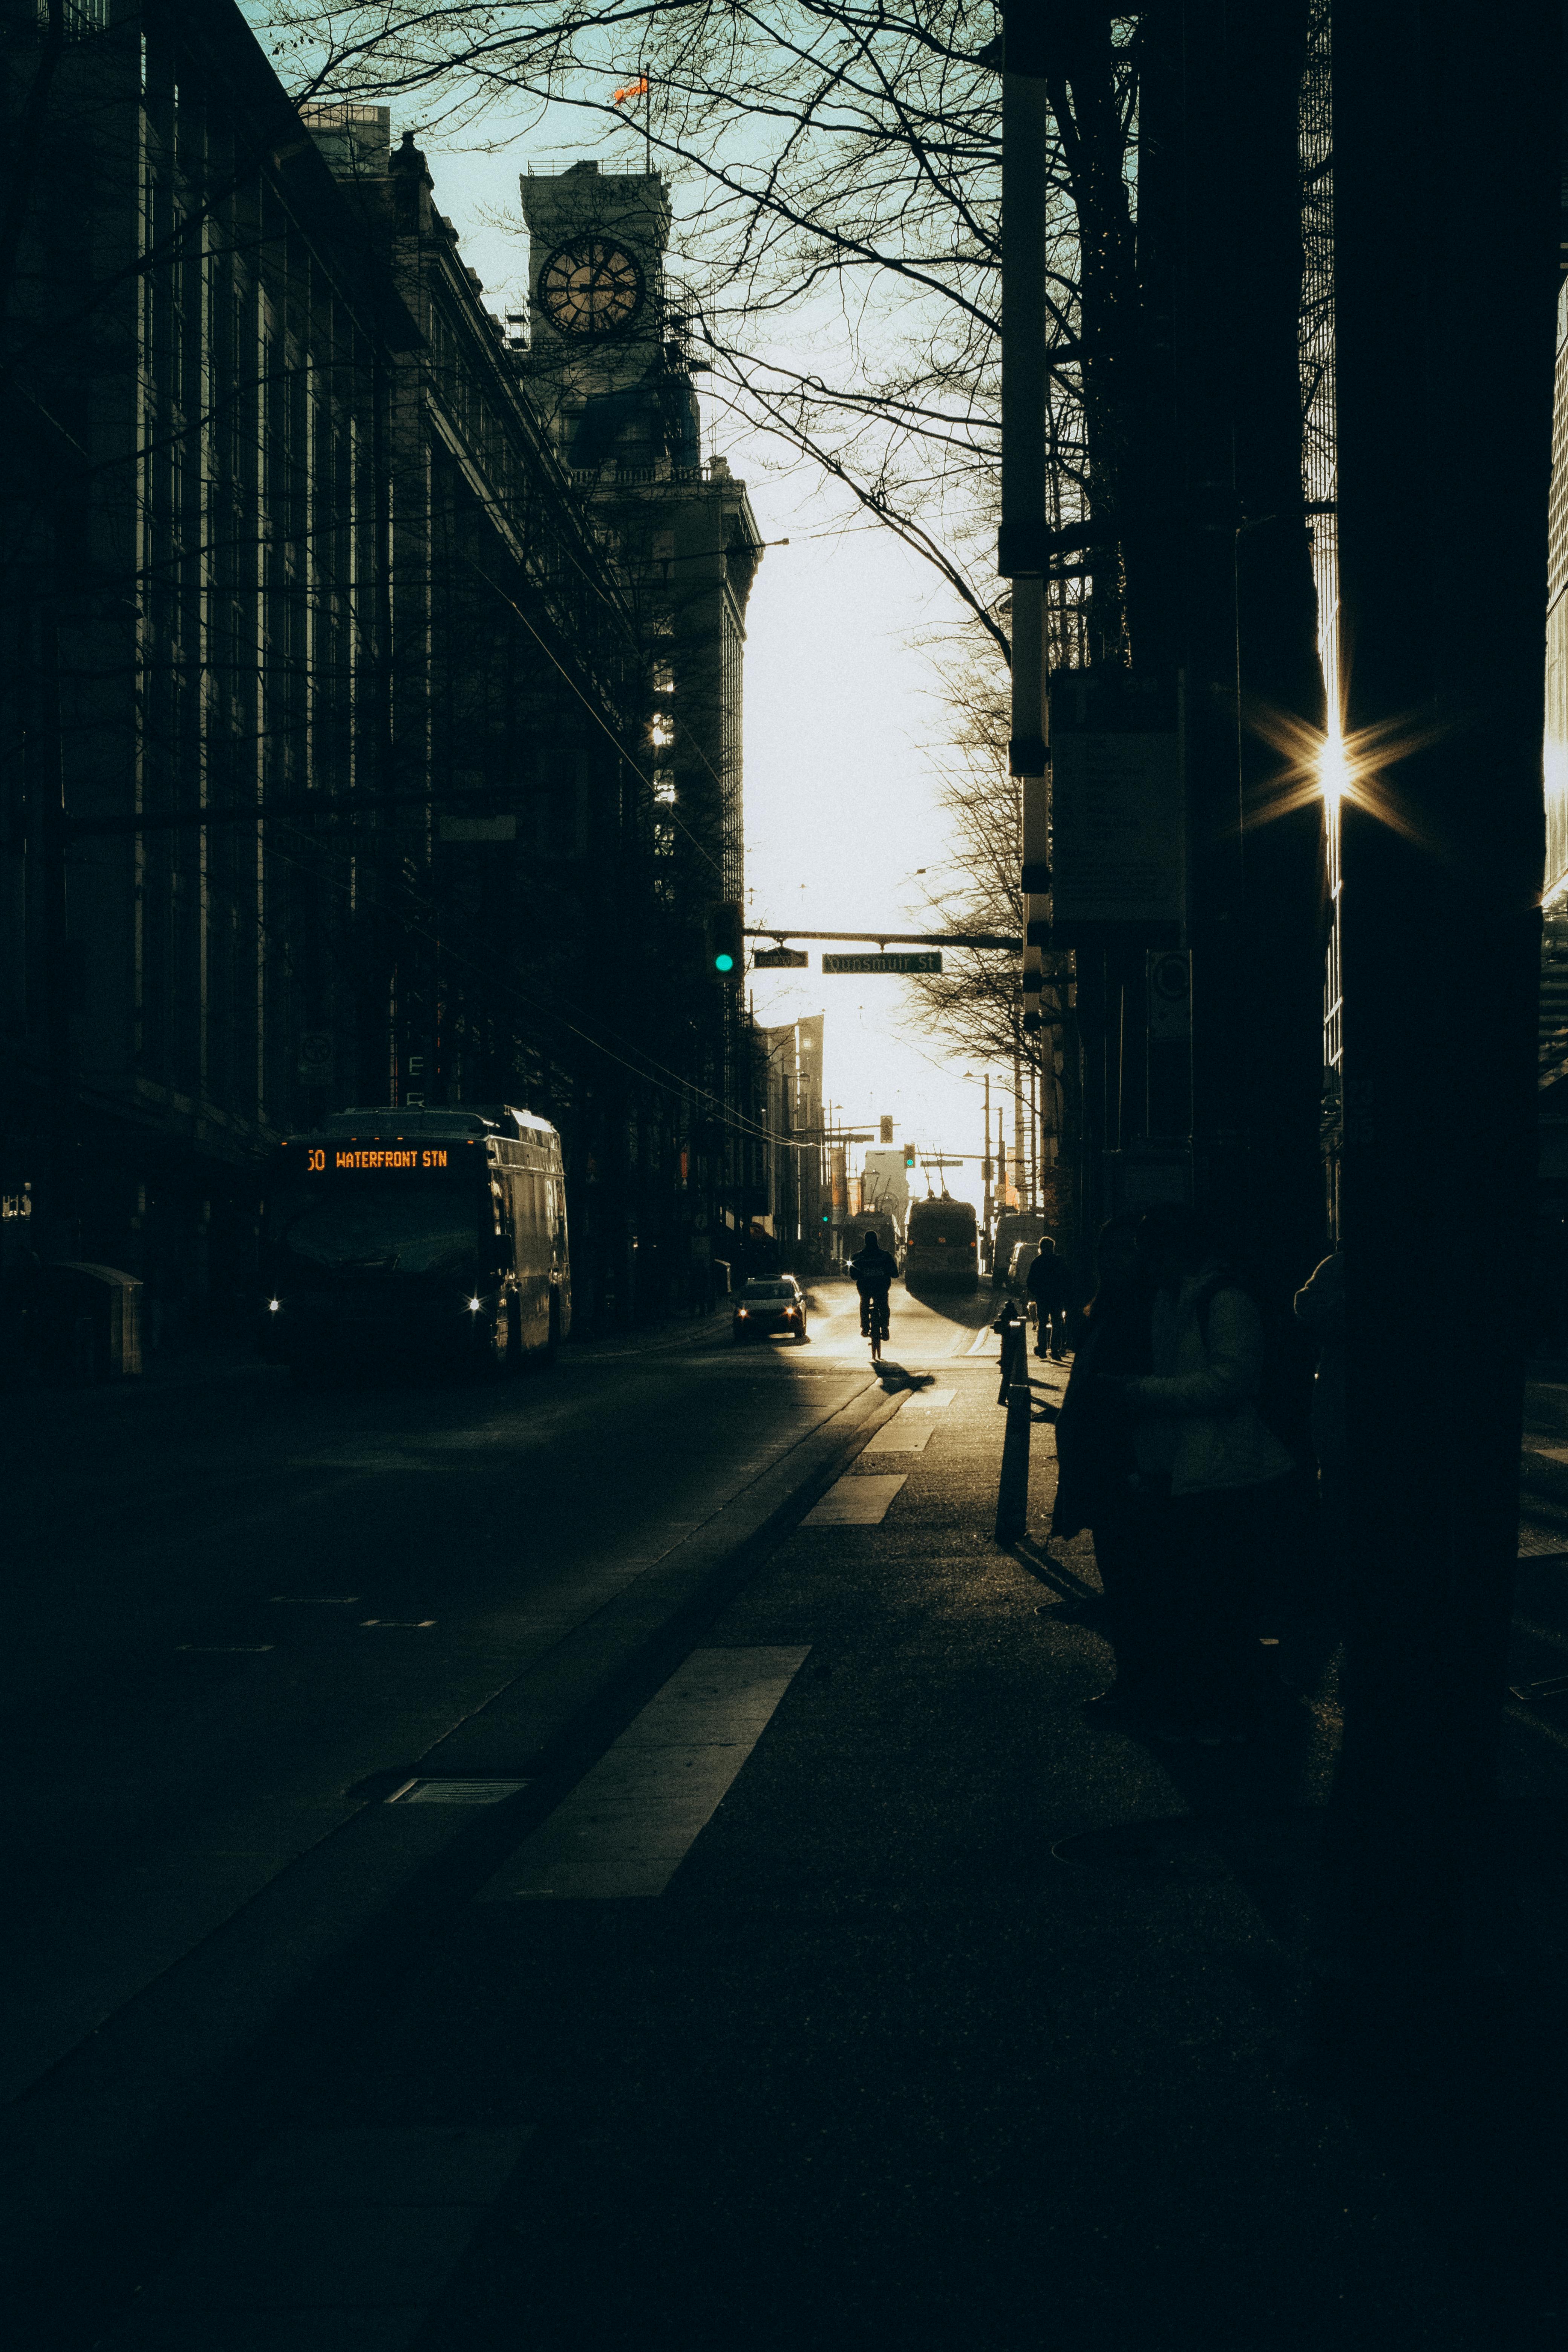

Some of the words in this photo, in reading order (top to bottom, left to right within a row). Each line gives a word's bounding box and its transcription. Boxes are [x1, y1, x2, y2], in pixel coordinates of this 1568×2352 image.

[829, 955, 910, 971] Dunsmuir
[918, 955, 934, 970] St
[336, 1151, 417, 1168] WATERFRONT
[423, 1150, 447, 1167] STN
